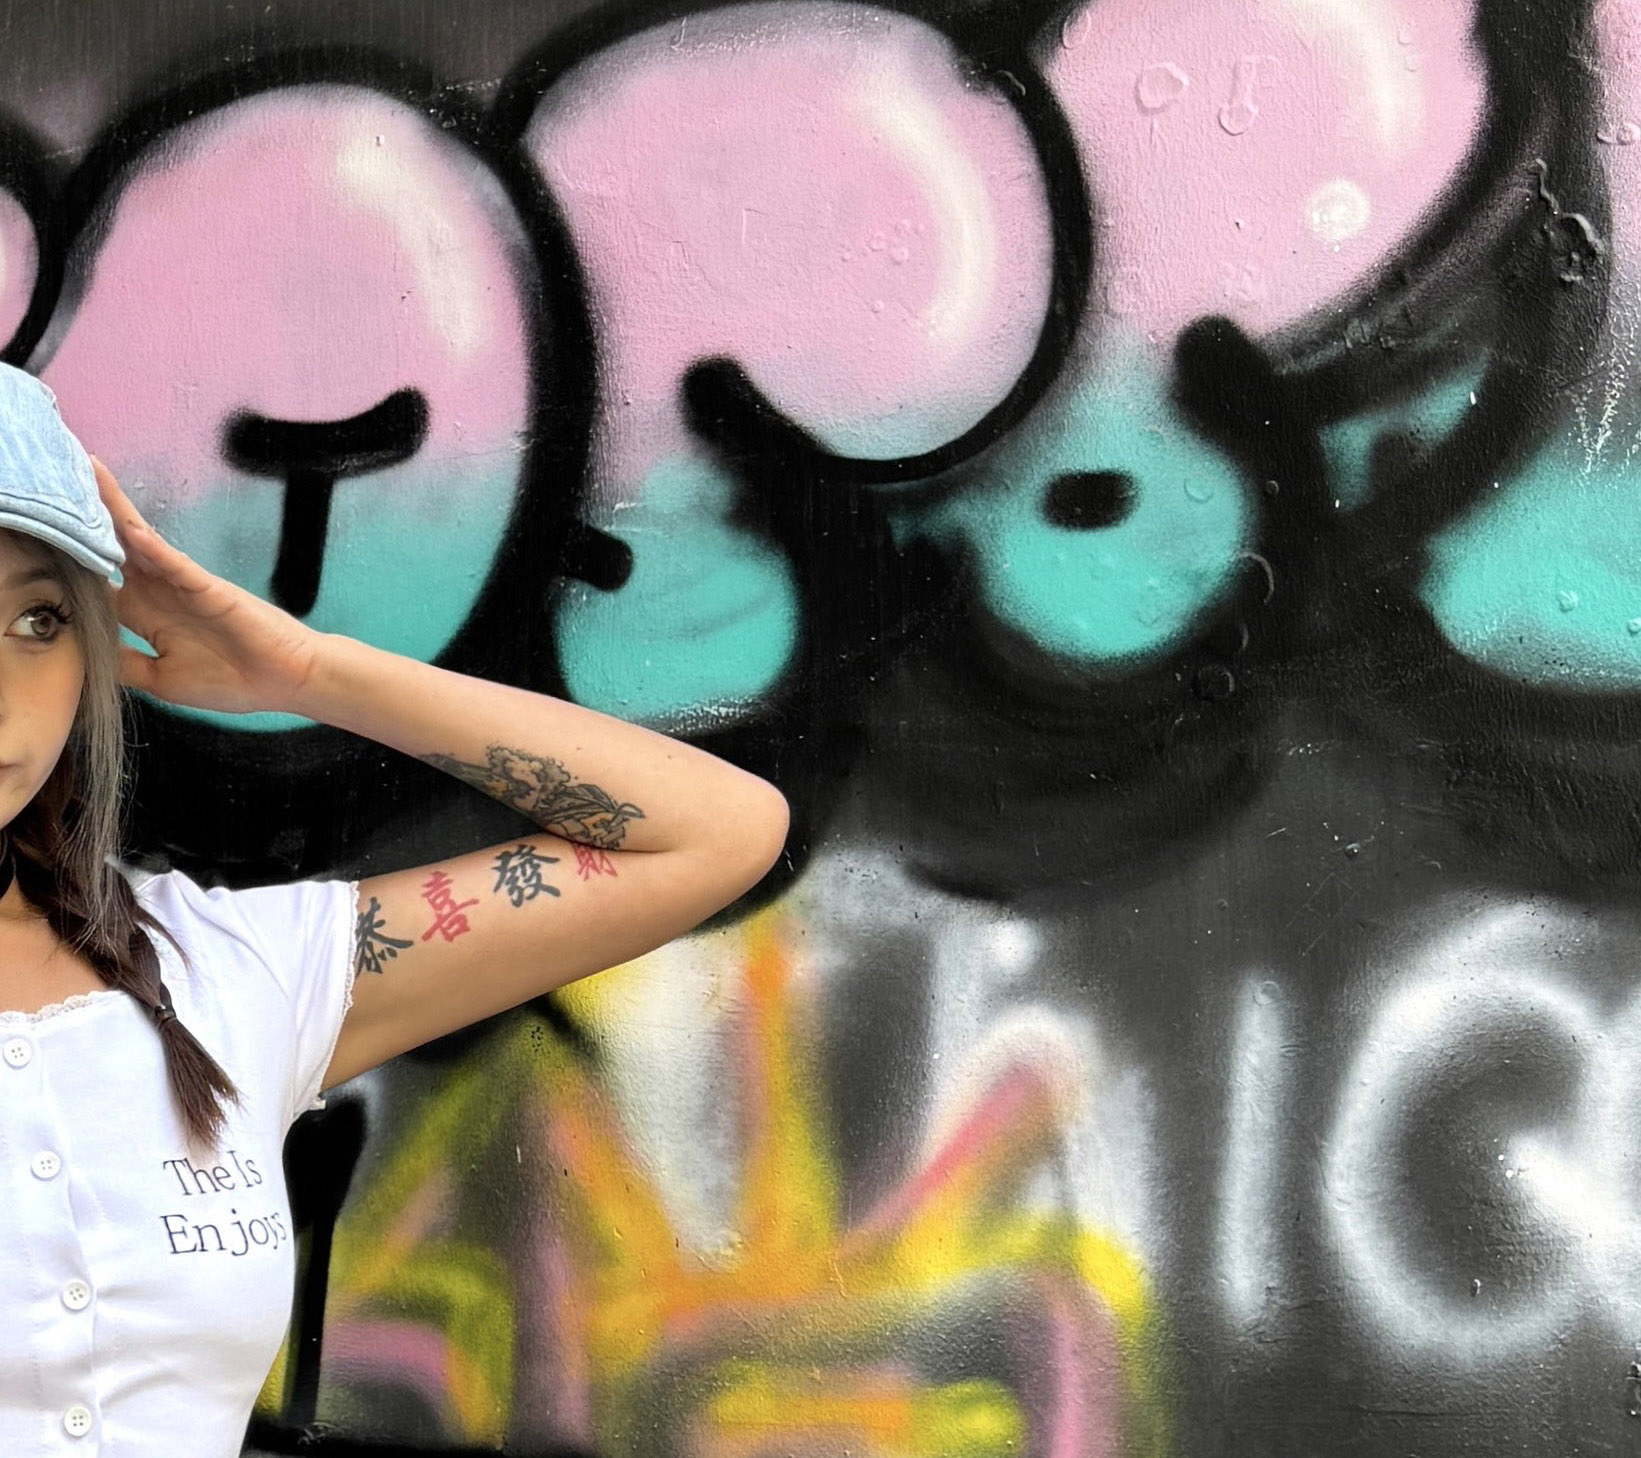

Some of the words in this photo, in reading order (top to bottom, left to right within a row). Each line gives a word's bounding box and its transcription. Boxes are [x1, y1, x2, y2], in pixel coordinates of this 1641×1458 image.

[357, 841, 618, 975] 恭喜發財
[163, 1157, 235, 1196] The
[226, 1150, 263, 1188] Is
[159, 1208, 287, 1257] Enjoys
